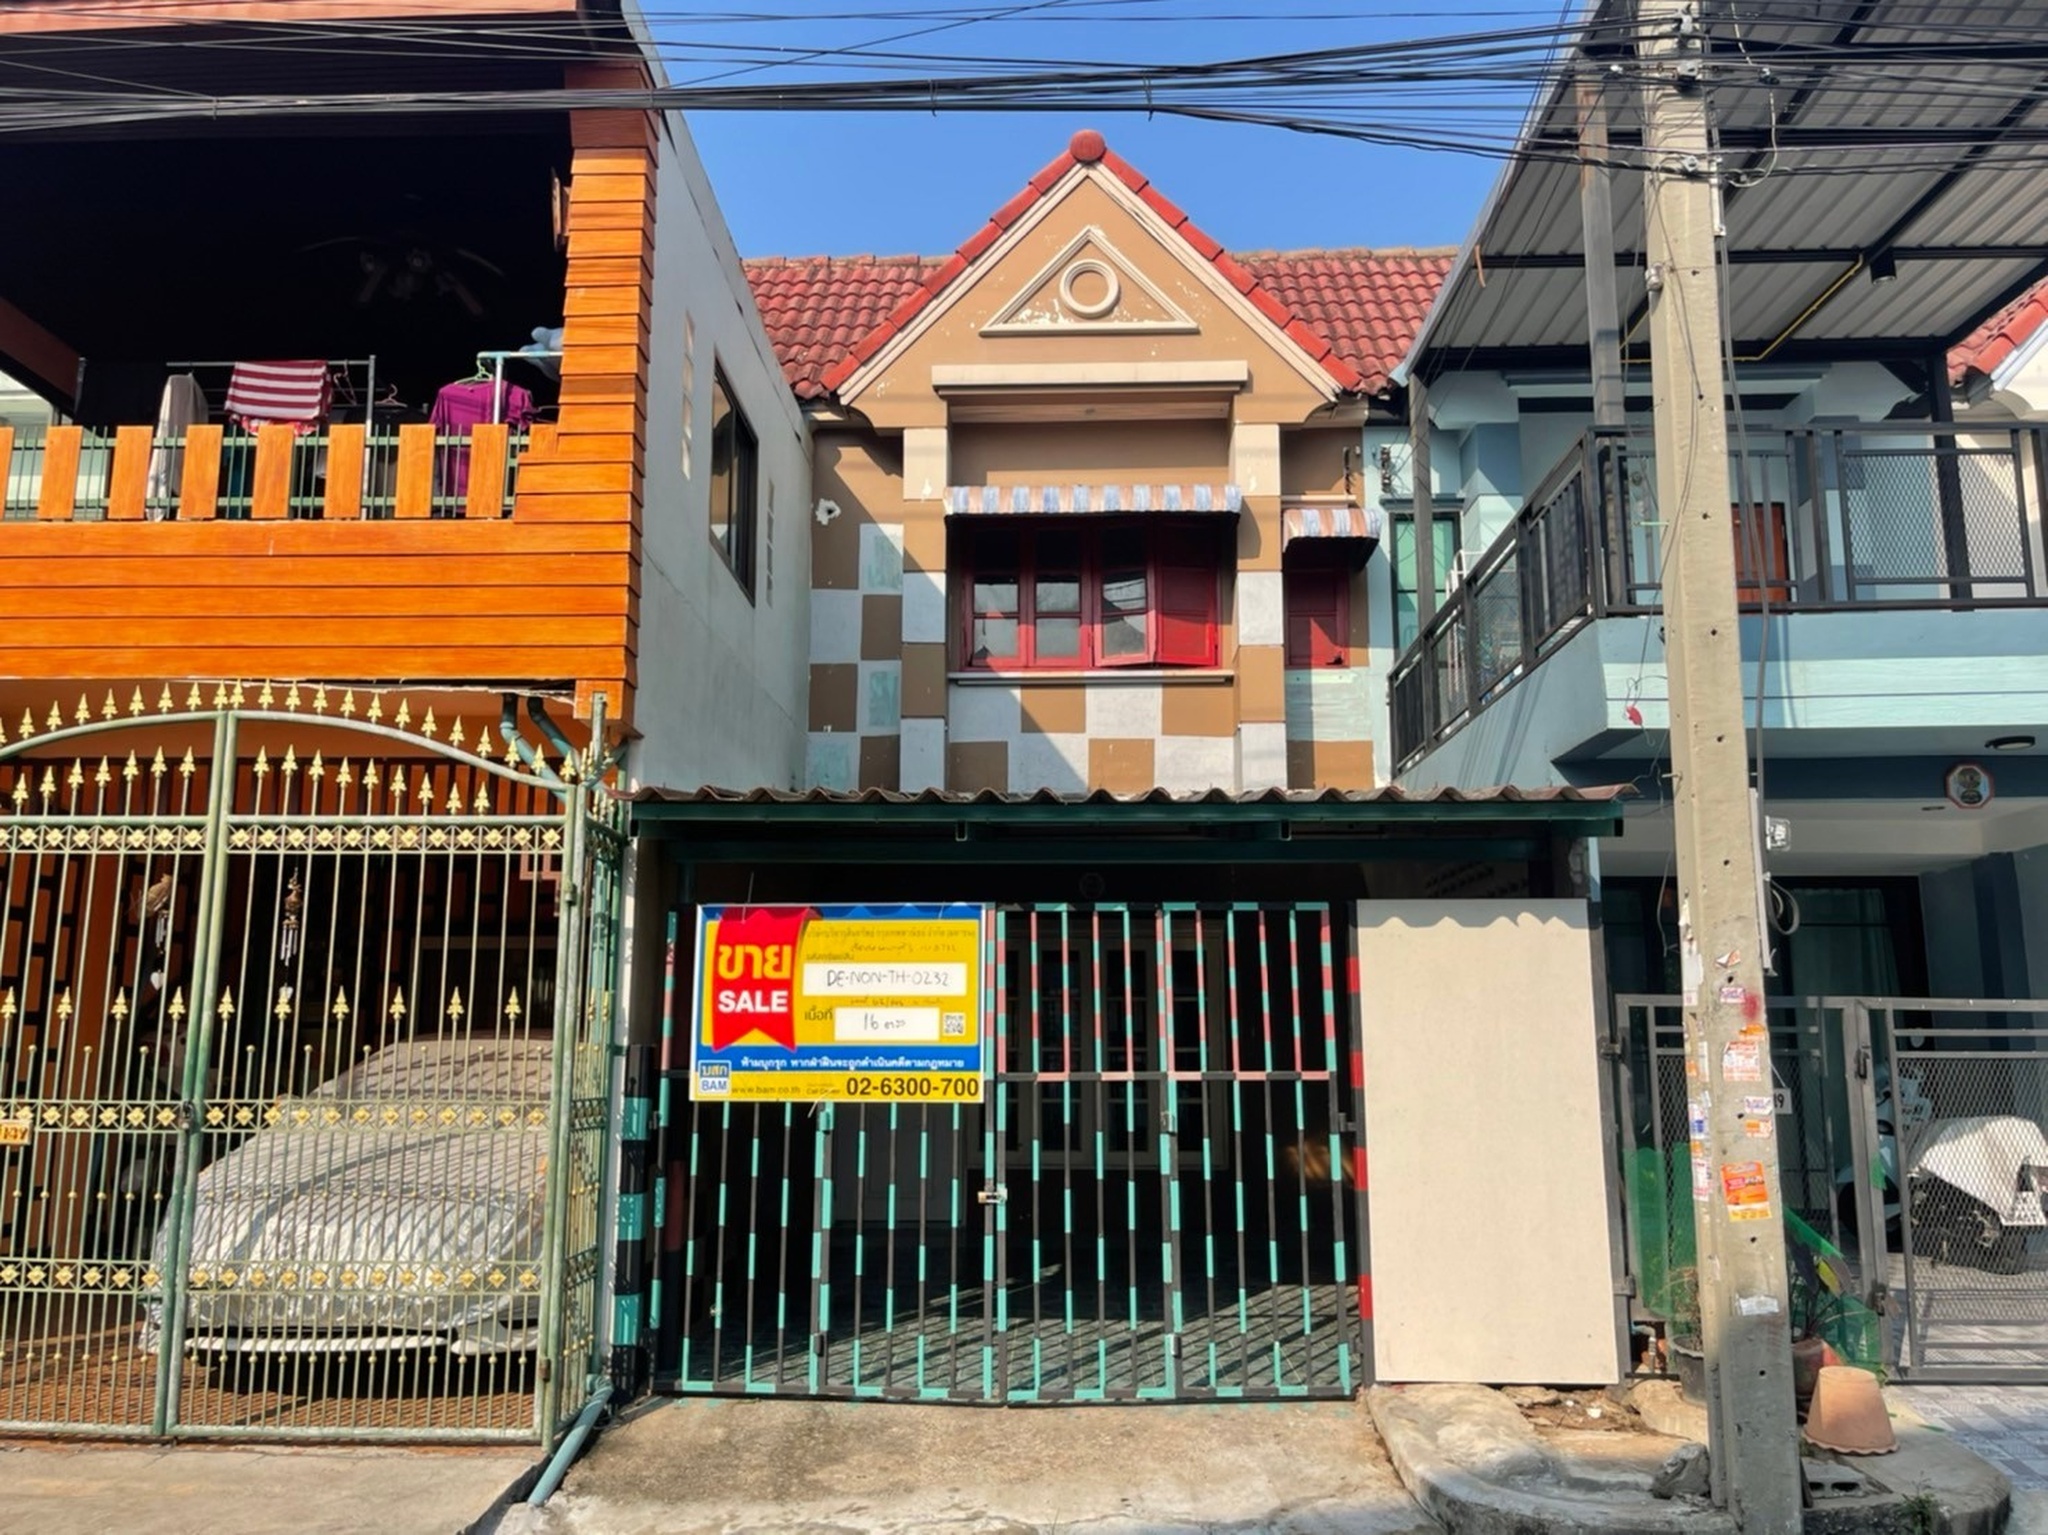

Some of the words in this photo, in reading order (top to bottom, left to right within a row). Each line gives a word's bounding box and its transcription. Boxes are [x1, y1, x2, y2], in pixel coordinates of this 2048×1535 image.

[717, 944, 792, 980] ขาย
[718, 990, 789, 1014] SALE
[804, 1002, 834, 1021] เนื้อที่
[701, 1079, 728, 1092] BAM
[731, 1085, 801, 1095] www.bam.co.th
[846, 1077, 979, 1097] 02-6300-700
